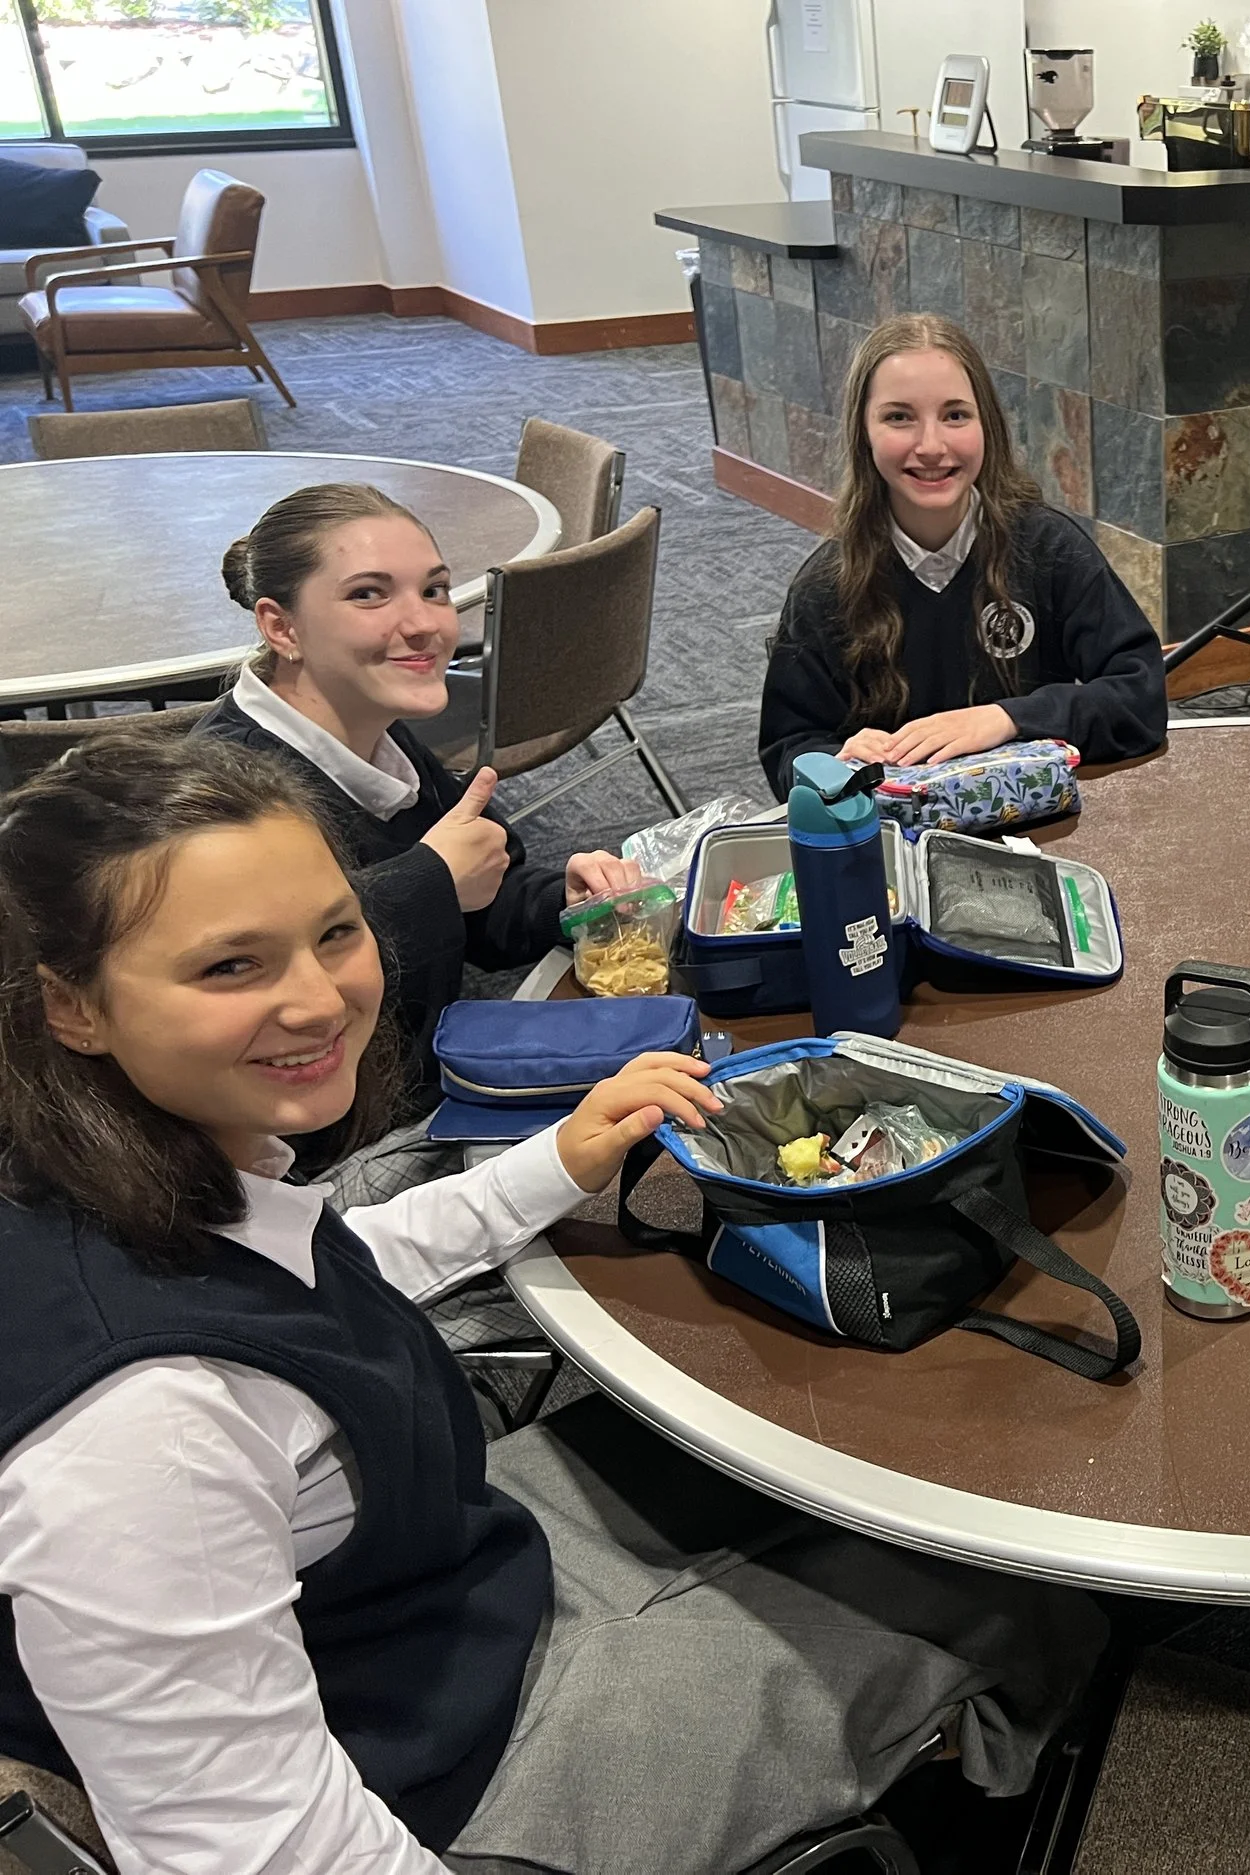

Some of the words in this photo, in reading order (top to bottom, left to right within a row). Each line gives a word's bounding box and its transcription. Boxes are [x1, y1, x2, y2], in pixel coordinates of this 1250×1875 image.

[1162, 1113, 1212, 1149] RAGEOUS
[1172, 1140, 1197, 1157] JOSHUA
[1200, 1149, 1212, 1159] 1:9
[1229, 1140, 1247, 1160] Be
[1176, 1250, 1207, 1270] BLESSE
